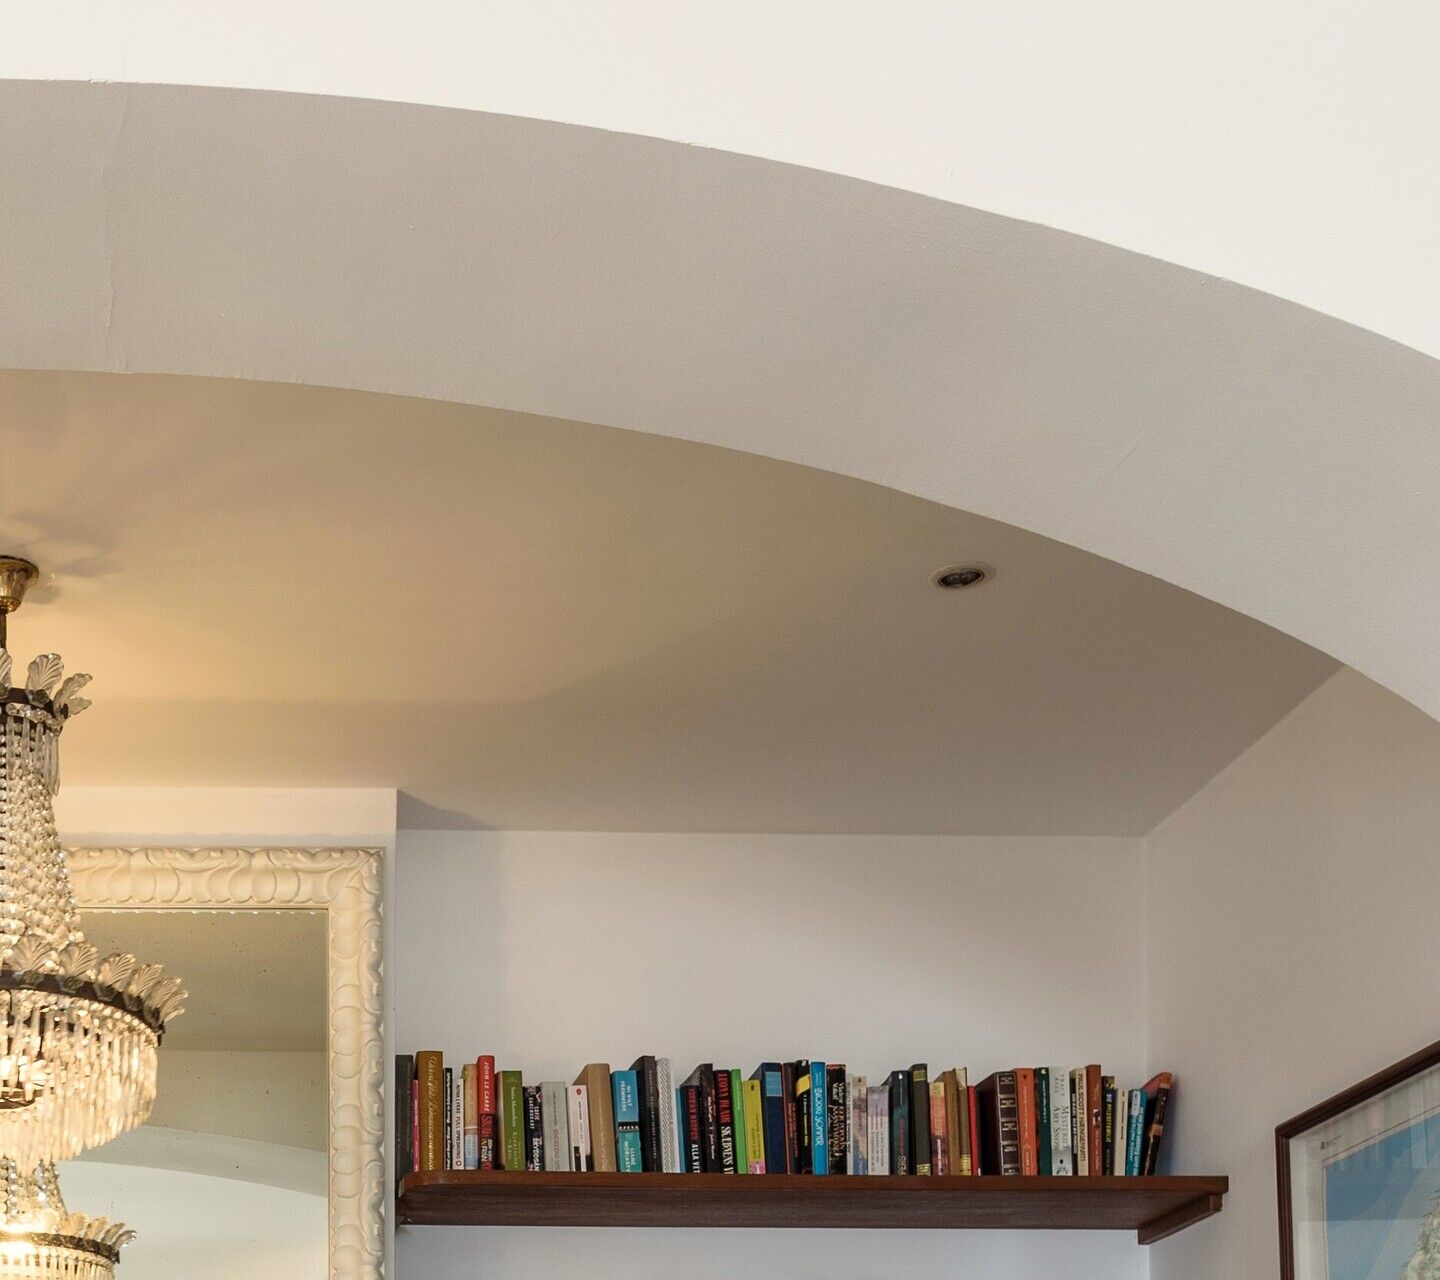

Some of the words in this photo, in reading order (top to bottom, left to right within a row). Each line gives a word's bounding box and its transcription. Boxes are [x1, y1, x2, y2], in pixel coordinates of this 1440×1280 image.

[1052, 1105, 1061, 1126] AMY
[1053, 1127, 1061, 1152] SNOW
[692, 1161, 700, 1173] VET
